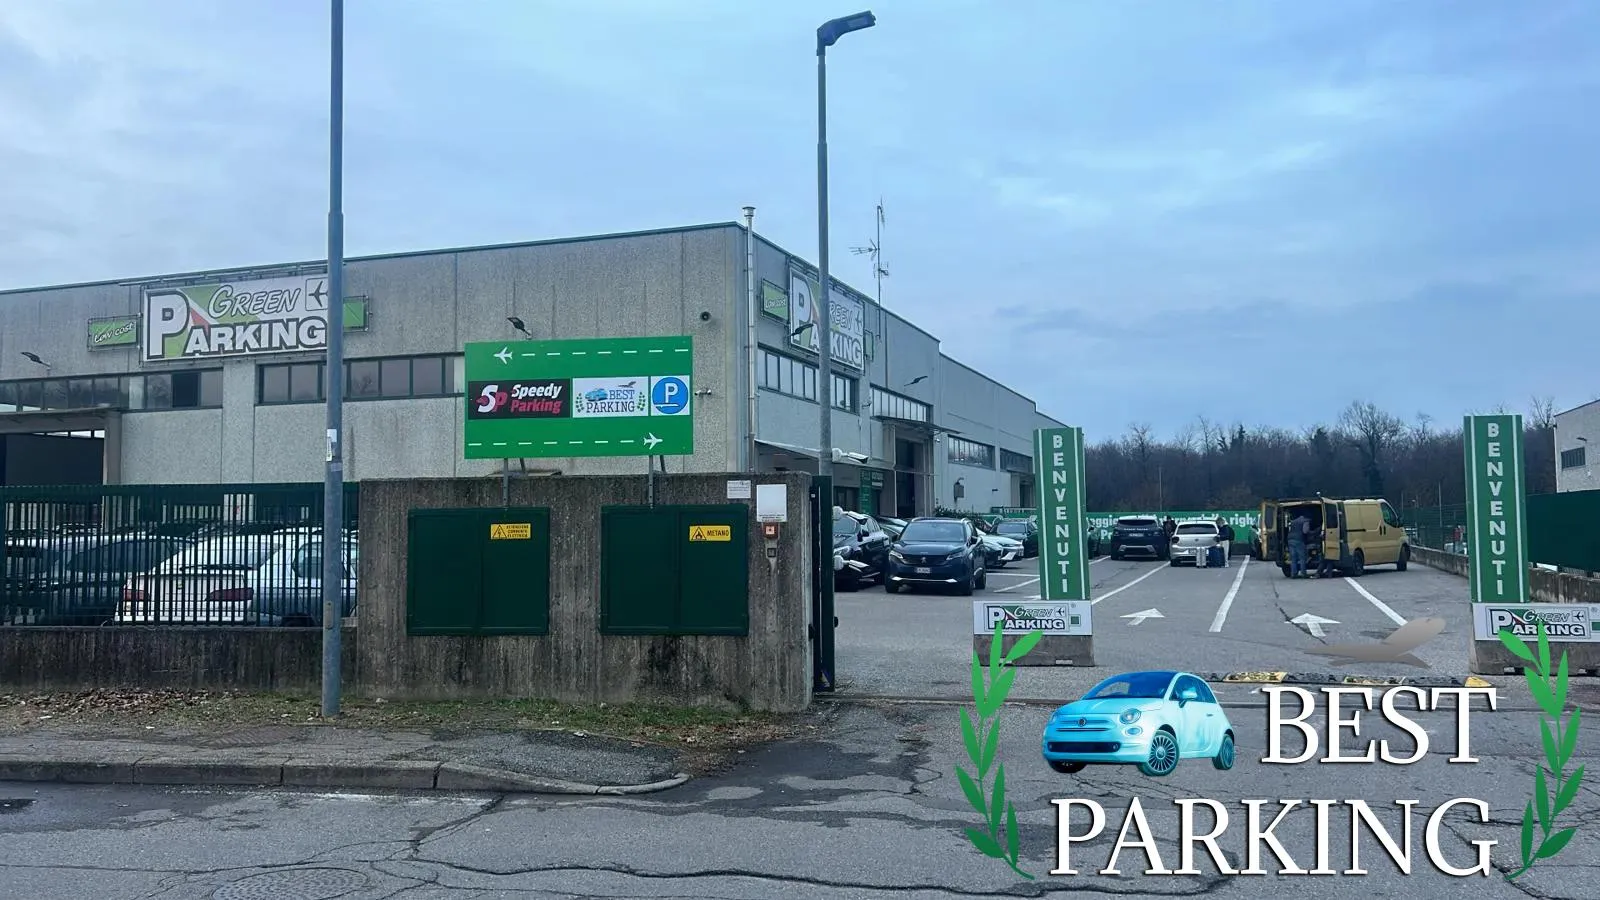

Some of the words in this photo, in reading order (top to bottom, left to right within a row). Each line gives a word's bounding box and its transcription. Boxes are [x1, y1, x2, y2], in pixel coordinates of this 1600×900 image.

[208, 284, 301, 319] GREEN
[147, 288, 327, 360] PARKING
[792, 276, 862, 366] PAKING
[829, 300, 853, 331] REEN
[511, 382, 563, 400] Speedy
[609, 389, 635, 401] BEST
[665, 383, 679, 404] P
[511, 399, 561, 414] Parking
[586, 400, 635, 413] PARKING
[1052, 434, 1070, 593] BENVENUTI
[1487, 422, 1506, 595] BENVENUTI
[706, 529, 730, 537] METANO
[987, 606, 1065, 630] PARKING
[1014, 606, 1052, 617] GREEN
